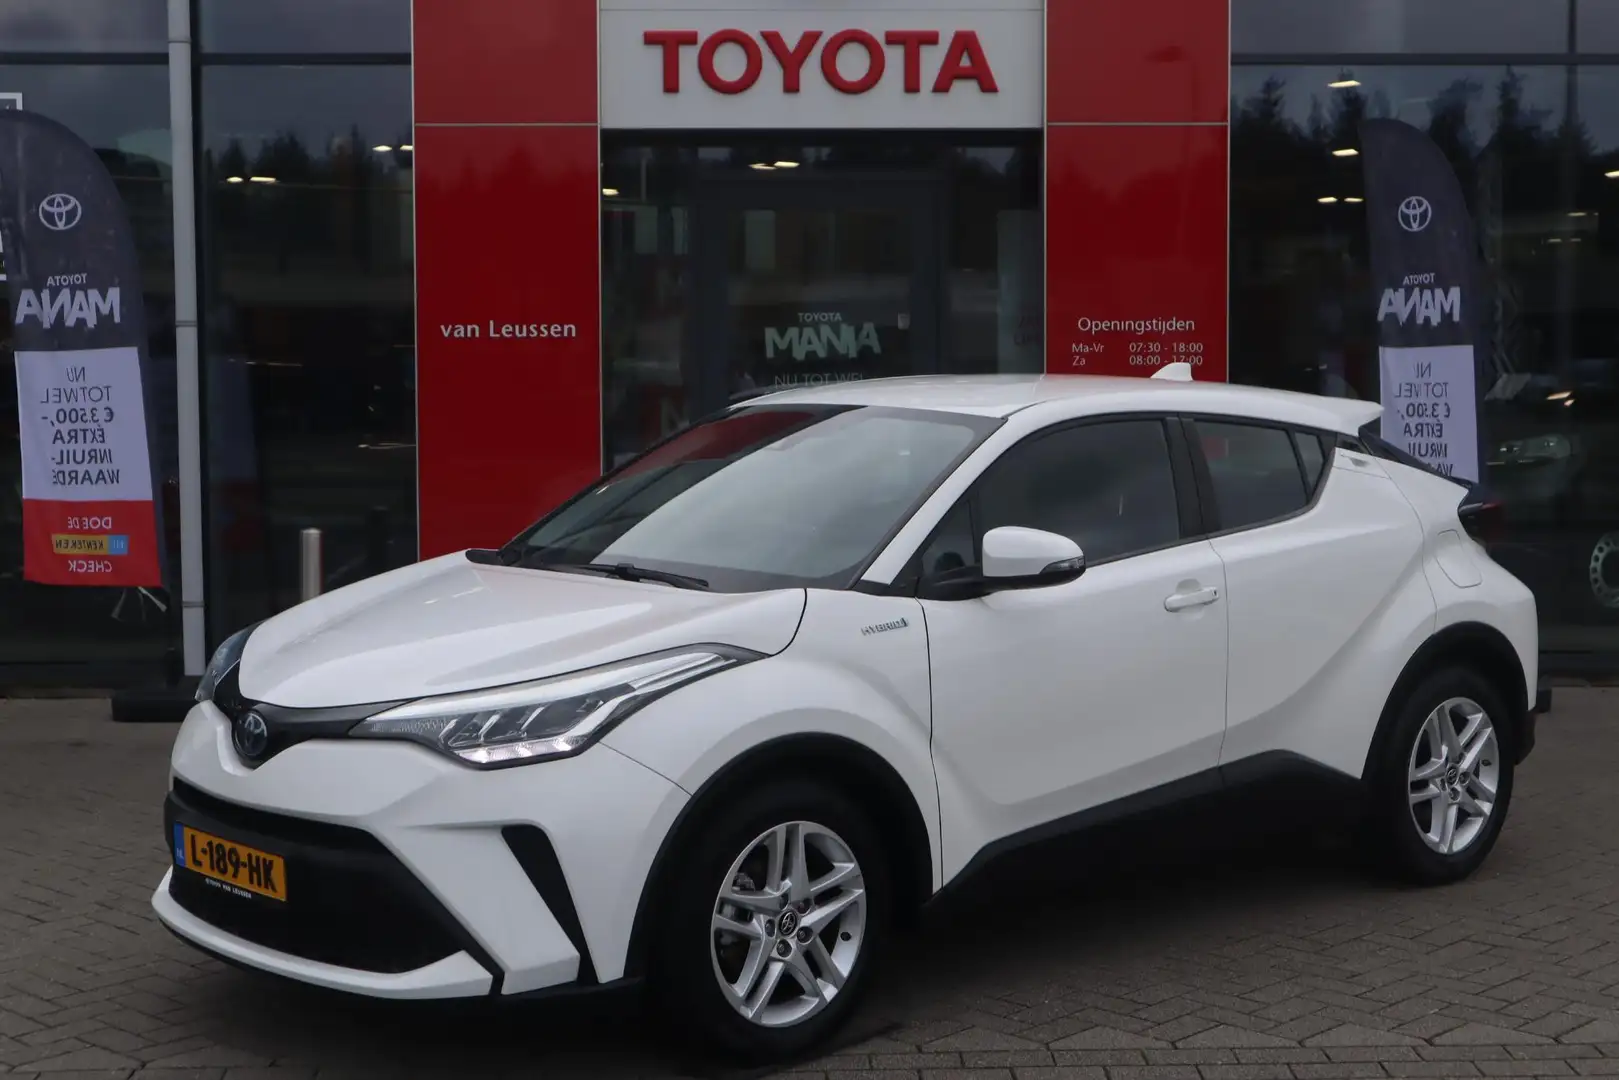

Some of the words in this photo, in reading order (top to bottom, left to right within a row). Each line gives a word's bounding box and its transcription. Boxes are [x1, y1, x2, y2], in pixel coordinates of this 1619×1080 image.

[643, 28, 999, 95] TOYOTA
[797, 312, 843, 322] TOYOTA
[1077, 317, 1195, 335] Openingstijden
[440, 324, 480, 338] van
[489, 320, 576, 338] Leussen
[764, 321, 882, 361] MANIA
[1071, 343, 1105, 353] Ma-Vr
[1129, 343, 1161, 353] 07:30
[1172, 343, 1203, 353] 18:00
[1072, 355, 1086, 366] Za
[1129, 355, 1161, 366] 08:00
[190, 834, 277, 893] L-189-HK
